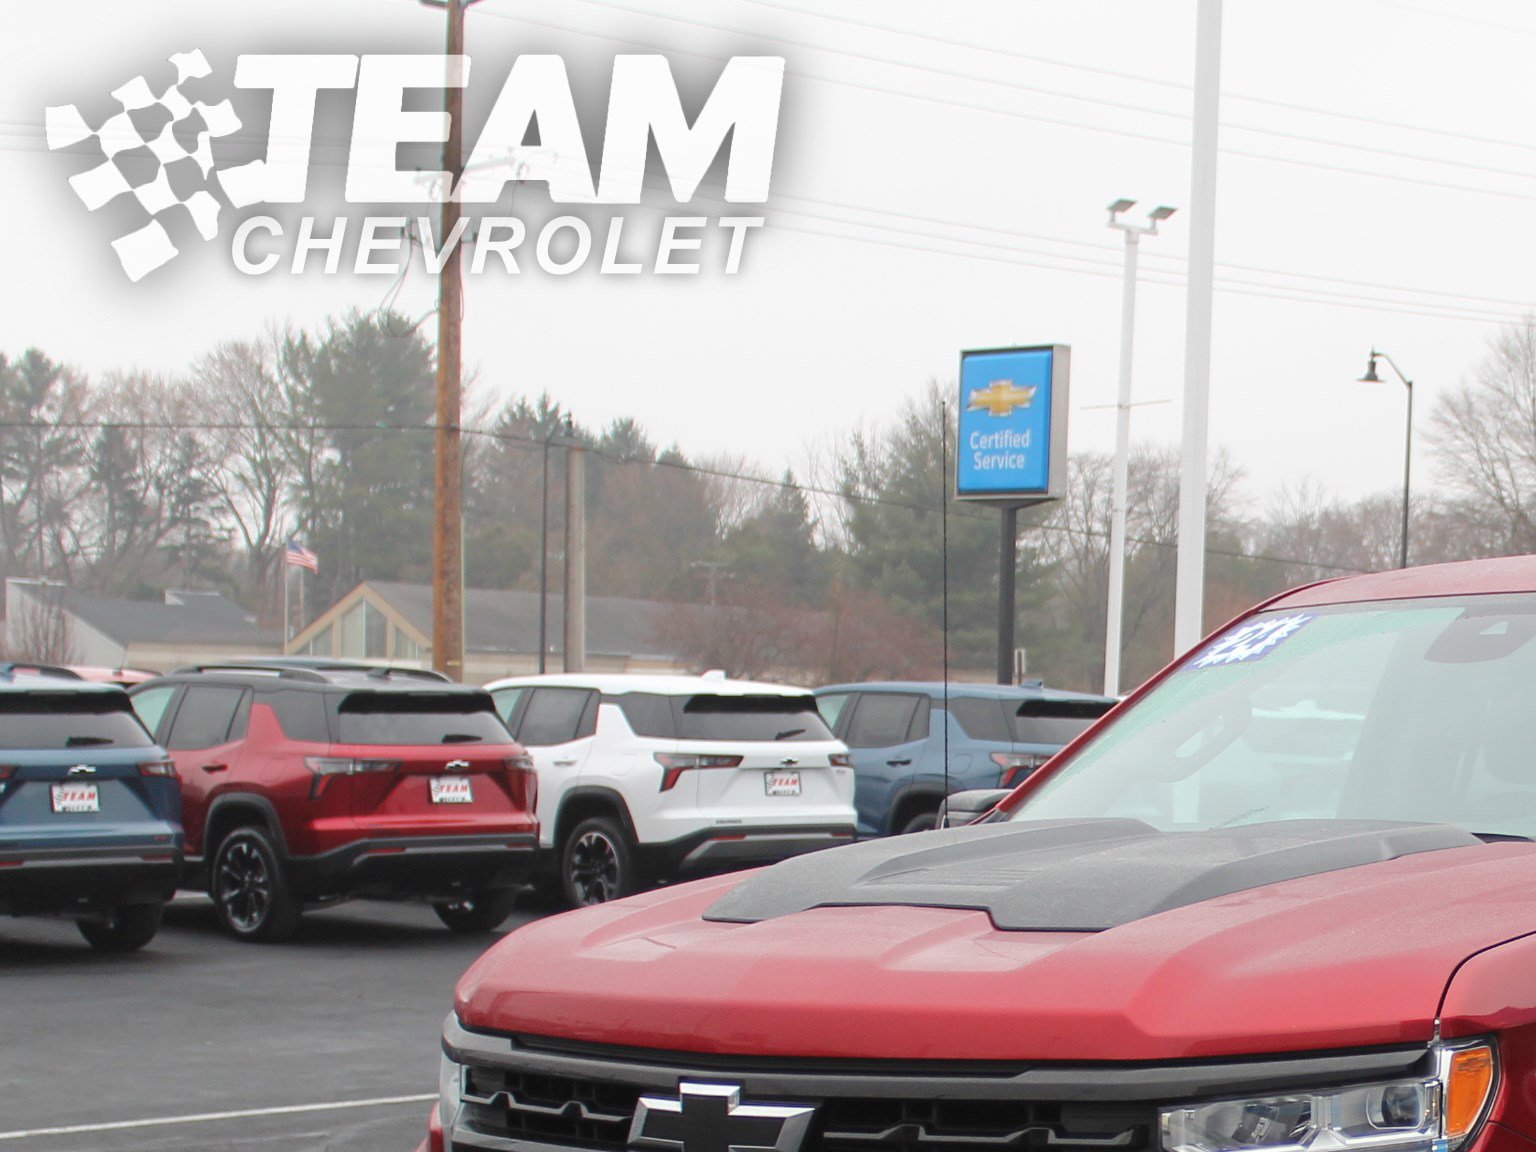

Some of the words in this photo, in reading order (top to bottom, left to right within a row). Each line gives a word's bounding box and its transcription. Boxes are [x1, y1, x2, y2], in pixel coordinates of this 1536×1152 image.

[969, 429, 1031, 450] Certified
[973, 451, 1025, 470] Service
[773, 778, 798, 786] TEAM
[440, 784, 468, 793] TEAM
[63, 791, 96, 801] TEAM
